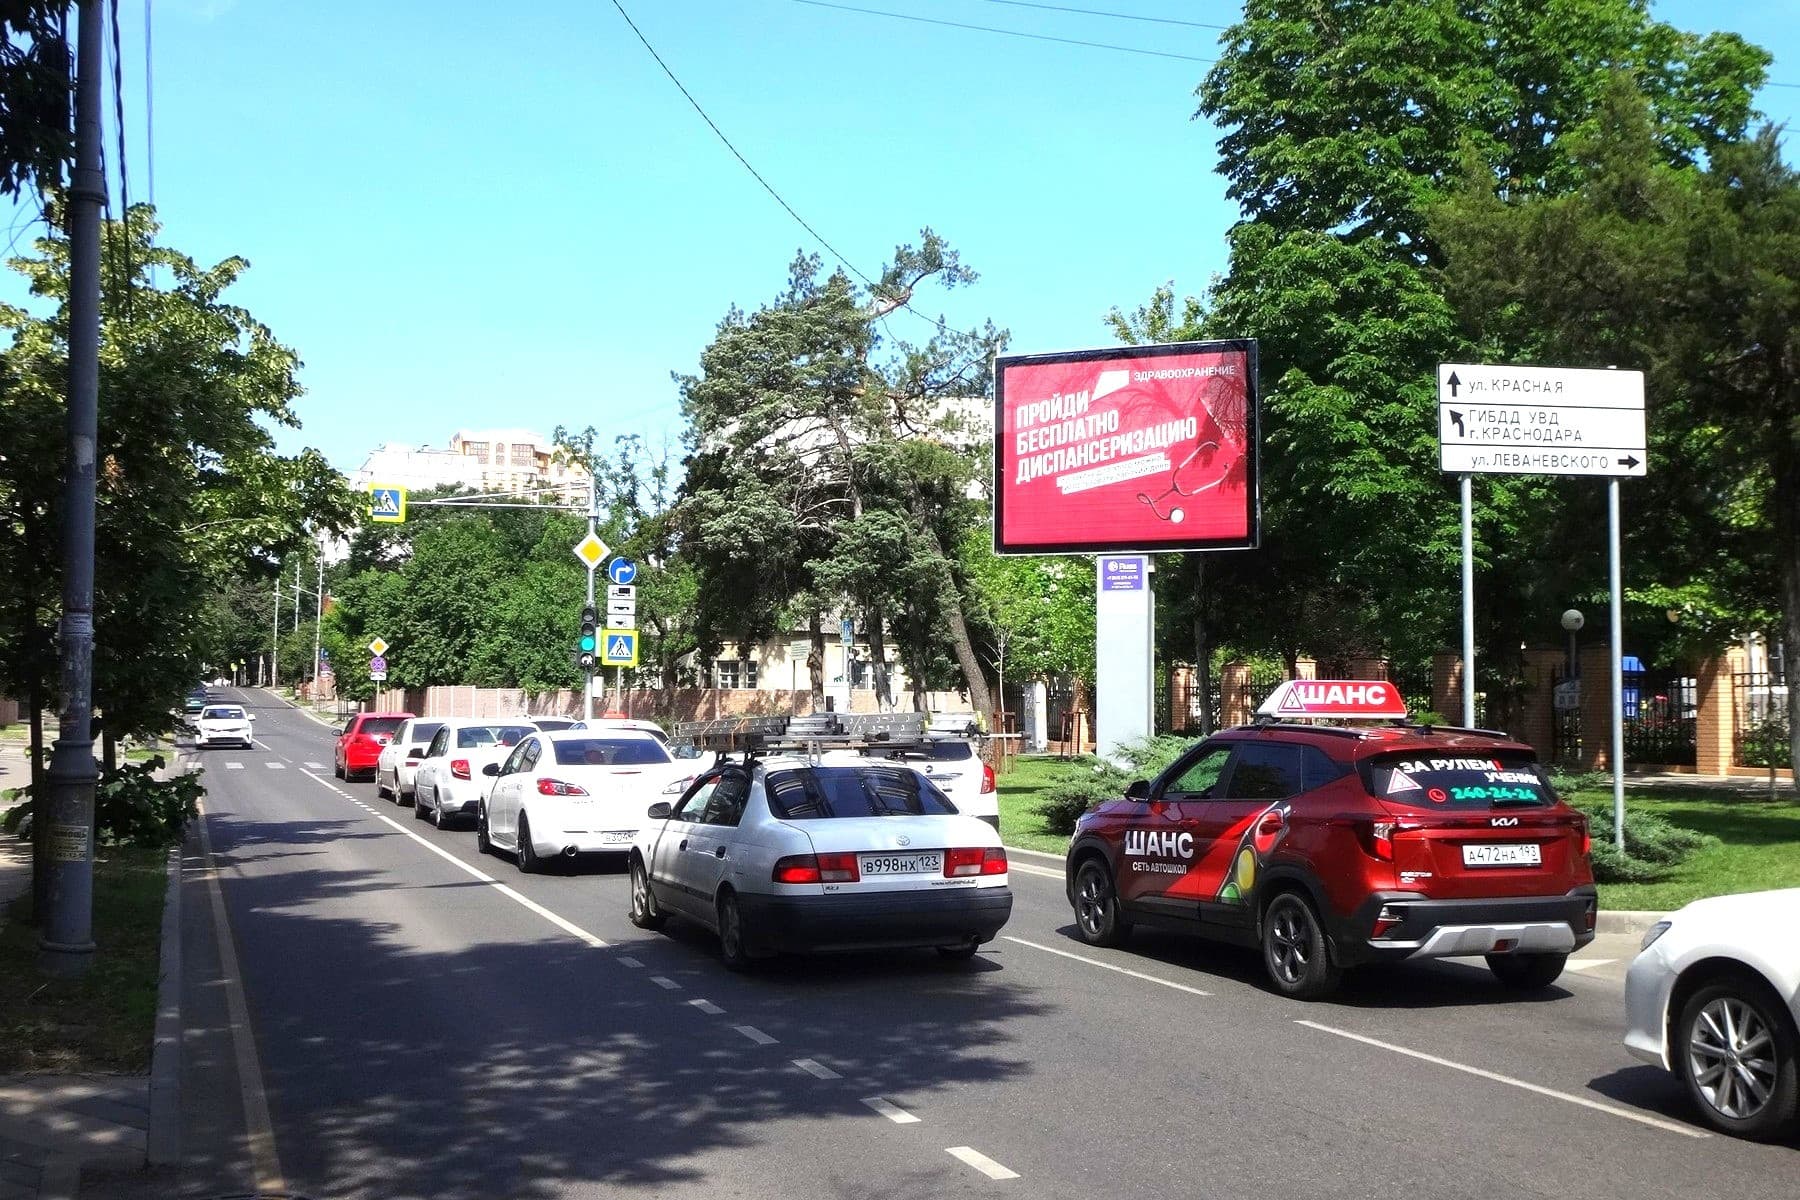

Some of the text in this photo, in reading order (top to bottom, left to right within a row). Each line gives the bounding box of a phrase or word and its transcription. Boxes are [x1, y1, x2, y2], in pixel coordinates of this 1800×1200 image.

[1133, 365, 1236, 381] ЗДРАВООХРАНЕНИЕ
[1492, 379, 1564, 393] КРАСНАЯ
[1016, 390, 1089, 428] ПРОЙДИ
[1469, 409, 1559, 426] ГИБДД УВД
[1016, 409, 1119, 455] БЕСПЛАТНО
[1016, 416, 1197, 485] ДИСПАНСЕРИЗАЦИЮ
[1298, 685, 1386, 706] ШАНС
[1400, 760, 1431, 774] ЗА
[1484, 772, 1542, 786] УЧЕНИК
[1451, 787, 1538, 801] 240-24-24
[1124, 830, 1194, 859] ШАНС
[1469, 847, 1517, 862] А472НА
[866, 856, 938, 873] В998НХ 123
[1132, 861, 1187, 875] СЕТЬ АВТОШКОЛ
